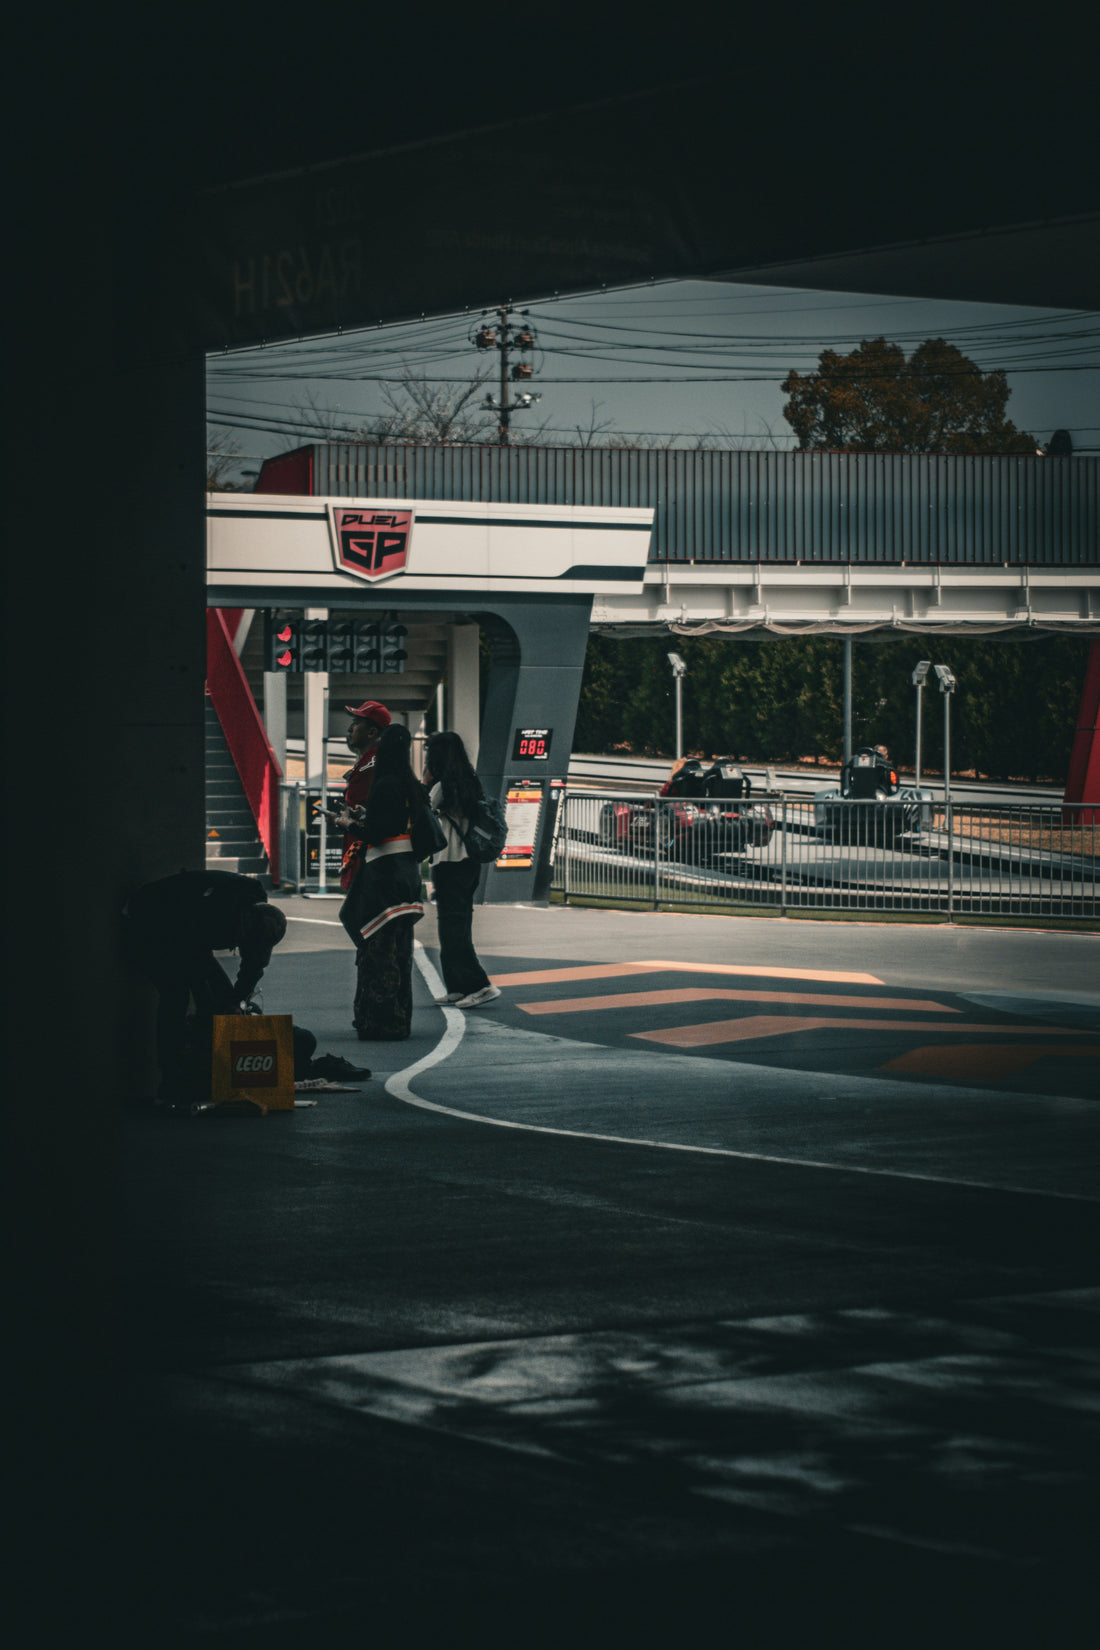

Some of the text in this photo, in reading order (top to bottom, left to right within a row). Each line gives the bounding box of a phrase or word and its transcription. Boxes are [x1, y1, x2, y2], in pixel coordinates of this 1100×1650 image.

[341, 514, 409, 528] DUEL
[341, 531, 408, 571] GP
[519, 739, 545, 755] 080
[236, 1056, 273, 1072] LEGO
